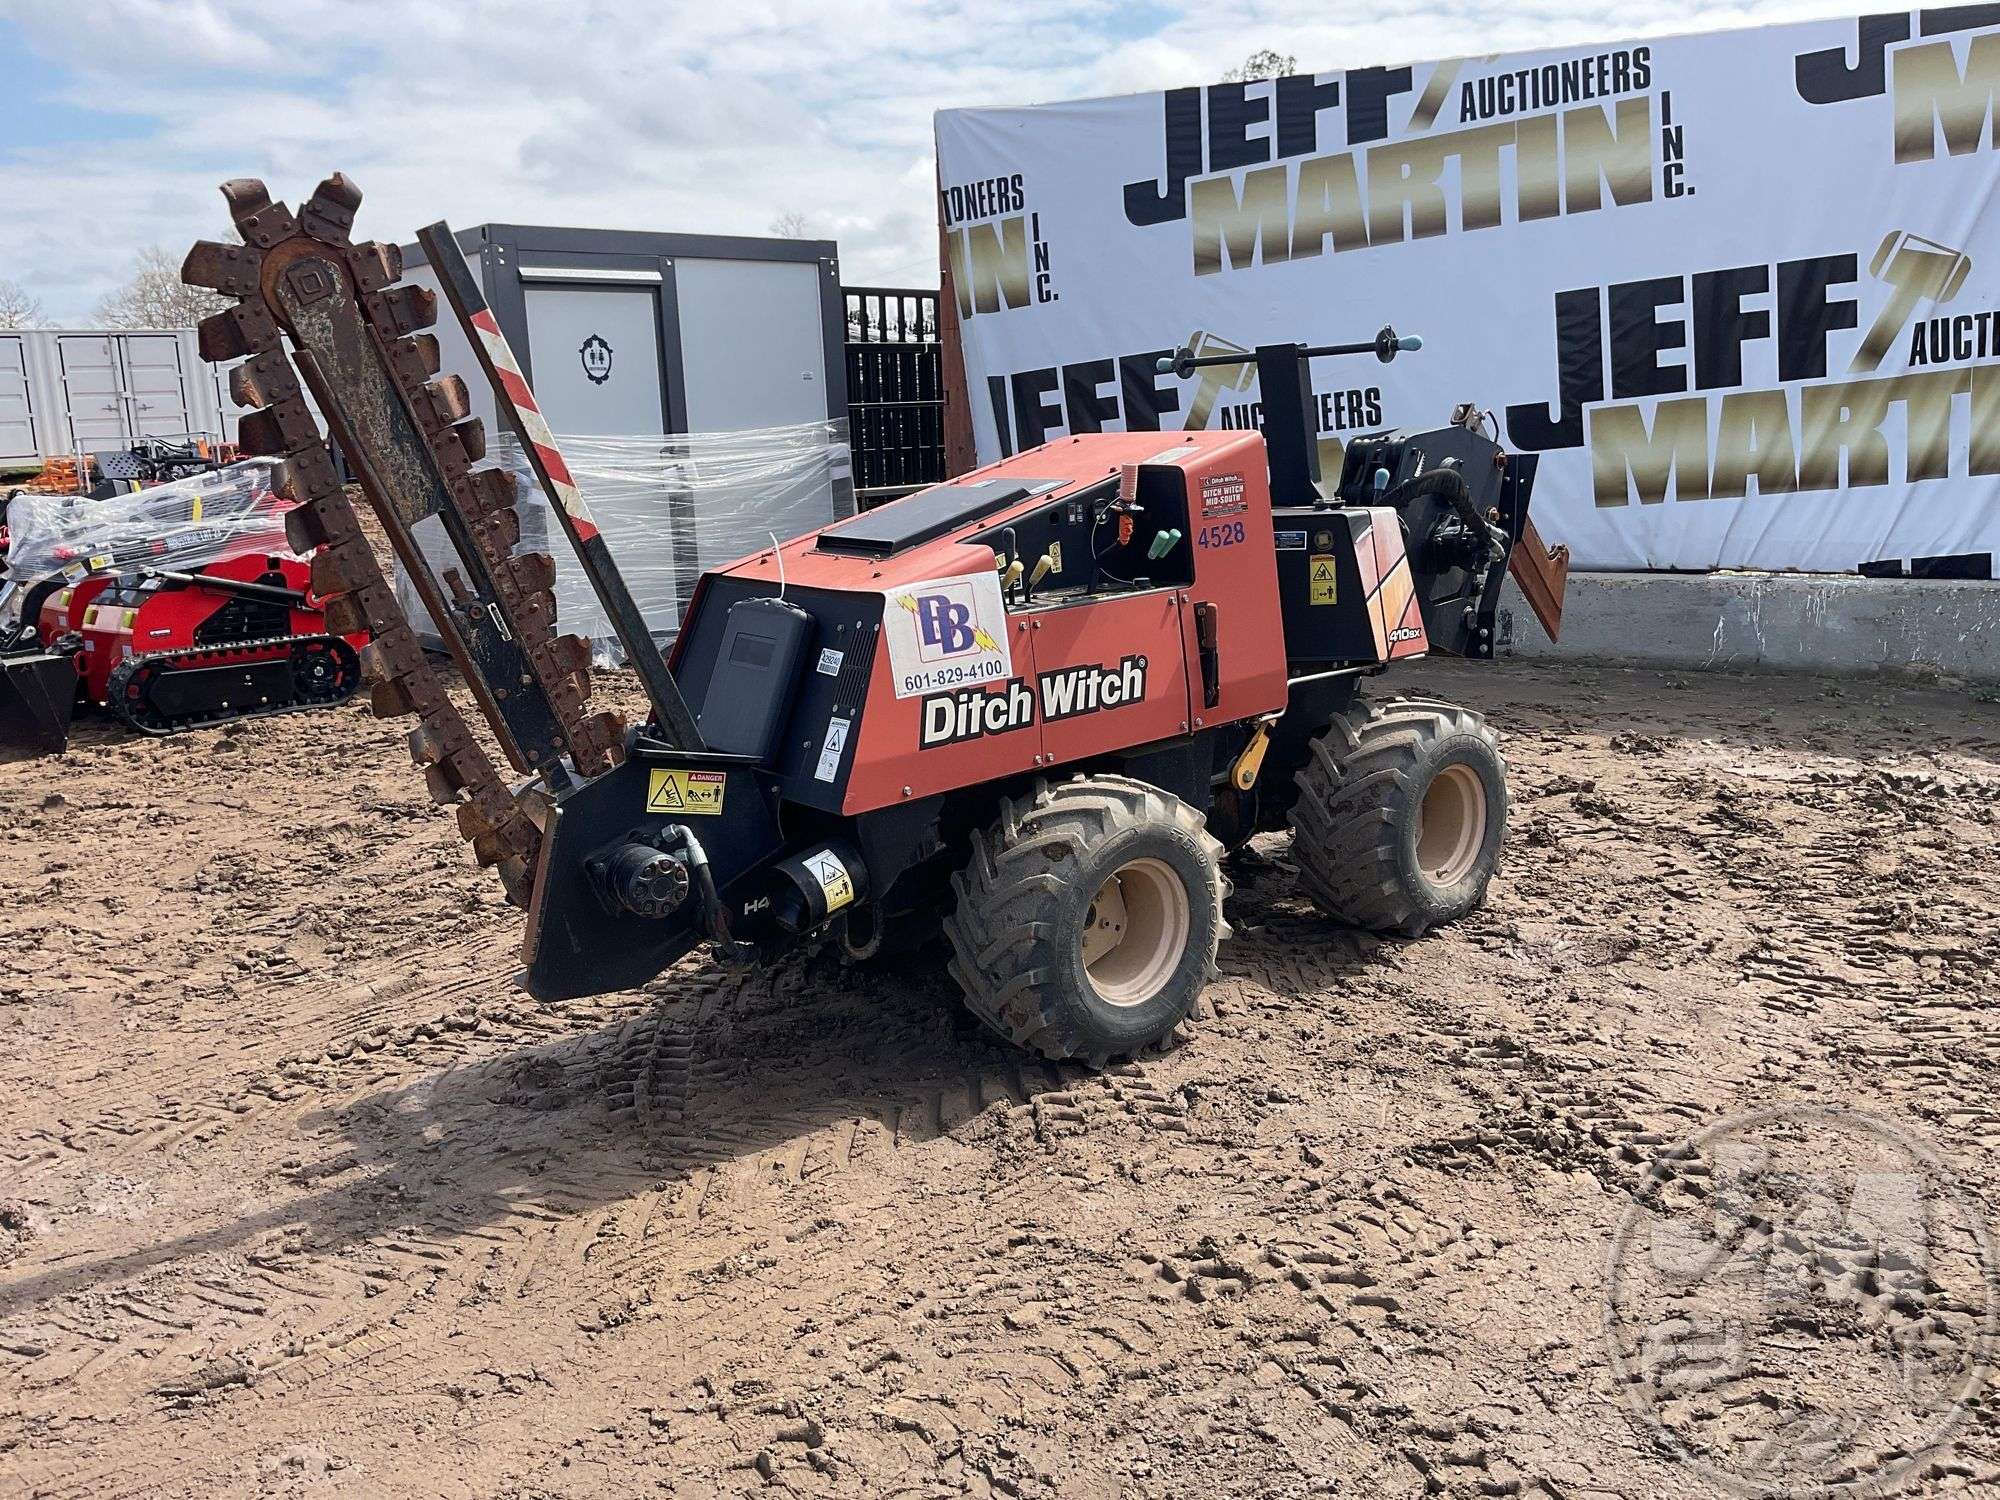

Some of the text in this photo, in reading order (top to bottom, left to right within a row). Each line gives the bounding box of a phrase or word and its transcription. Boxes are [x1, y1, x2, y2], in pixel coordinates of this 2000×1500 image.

[1460, 47, 1651, 123] AUCTIONEERS
[1191, 96, 1653, 276] MARTIN
[1506, 253, 1857, 451] JEFF
[1203, 484, 1244, 498] DITCH WITCH
[1205, 494, 1241, 506] MID-SOUTH
[1198, 521, 1245, 549] 4528
[905, 660, 1002, 691] 601-829-4100
[924, 683, 1032, 744] Ditch
